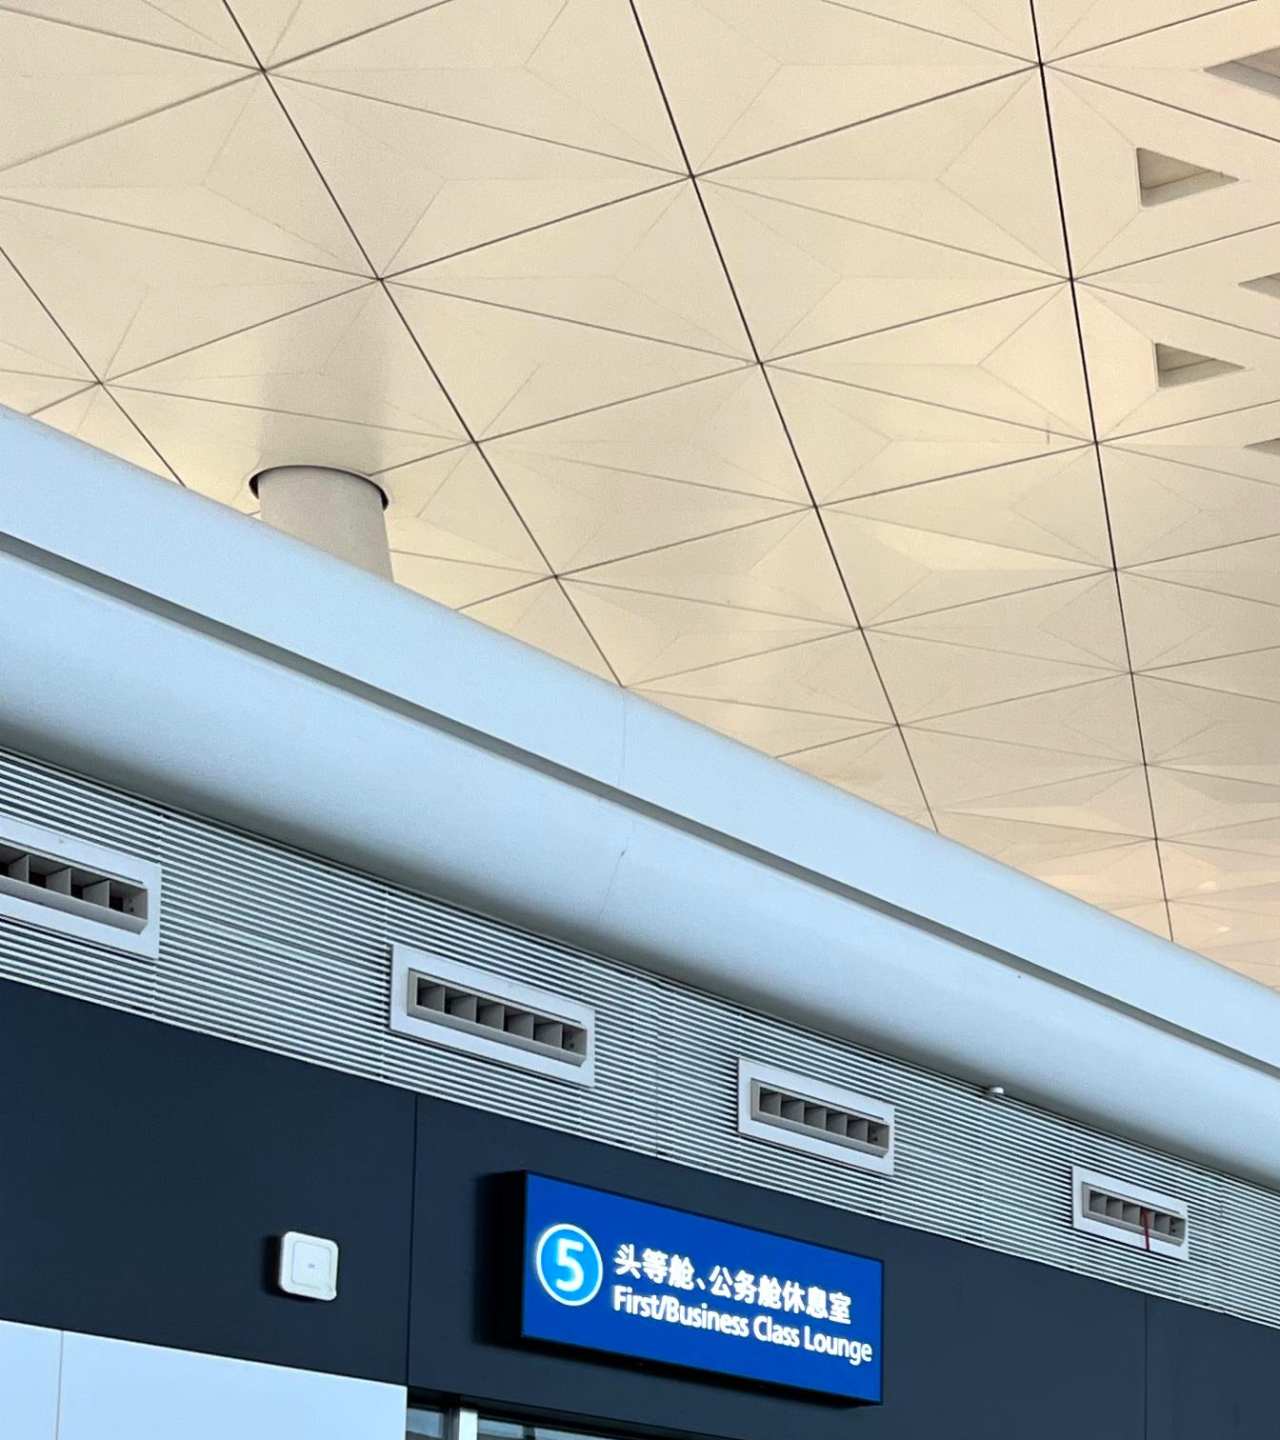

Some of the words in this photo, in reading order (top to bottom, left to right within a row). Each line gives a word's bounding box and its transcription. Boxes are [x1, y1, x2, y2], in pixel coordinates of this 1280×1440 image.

[555, 1238, 584, 1292] 5
[613, 1243, 852, 1325] 头等舱、公务舱休息室
[613, 1285, 750, 1338] First/Business
[753, 1316, 801, 1348] Class
[804, 1326, 873, 1366] Lounge
